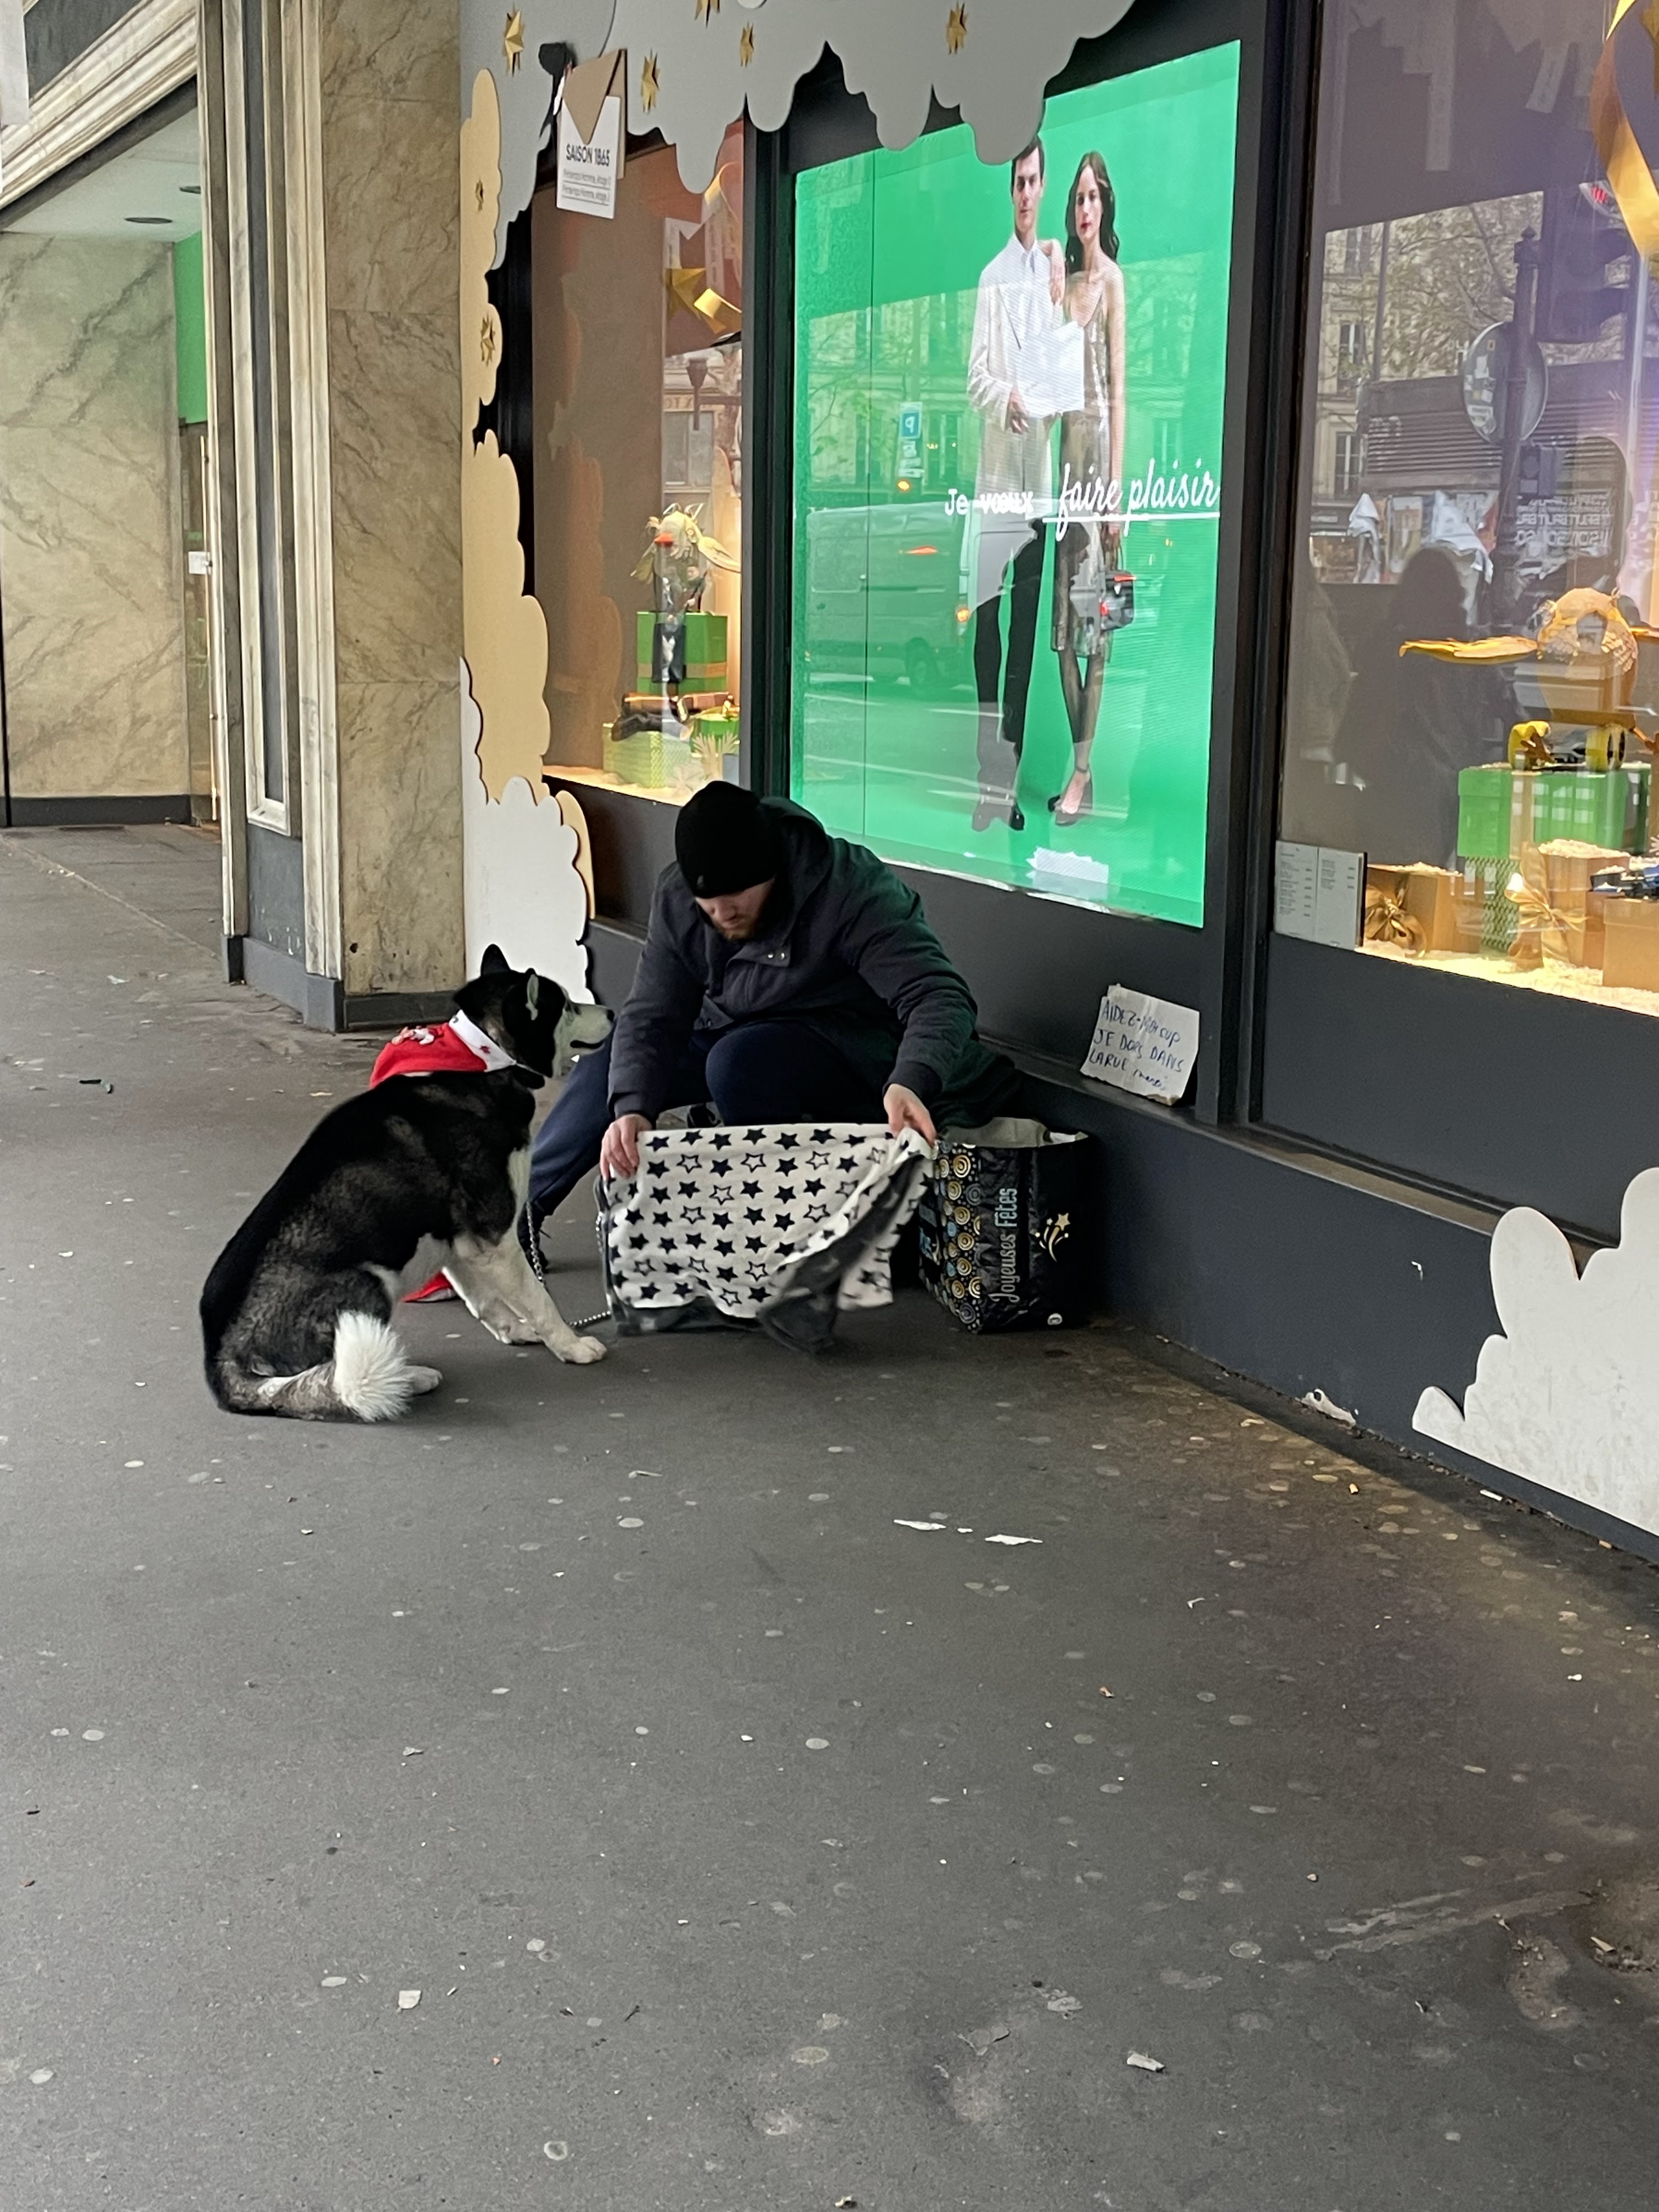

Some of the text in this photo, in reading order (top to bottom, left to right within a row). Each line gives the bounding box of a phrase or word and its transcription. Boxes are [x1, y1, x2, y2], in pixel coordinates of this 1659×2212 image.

[566, 143, 592, 163] SAISON
[945, 489, 969, 516] Je
[1056, 462, 1123, 541] faire
[1123, 458, 1221, 537] plaisir
[1150, 1046, 1185, 1073] DANS
[988, 1234, 1020, 1303] Joyeuses
